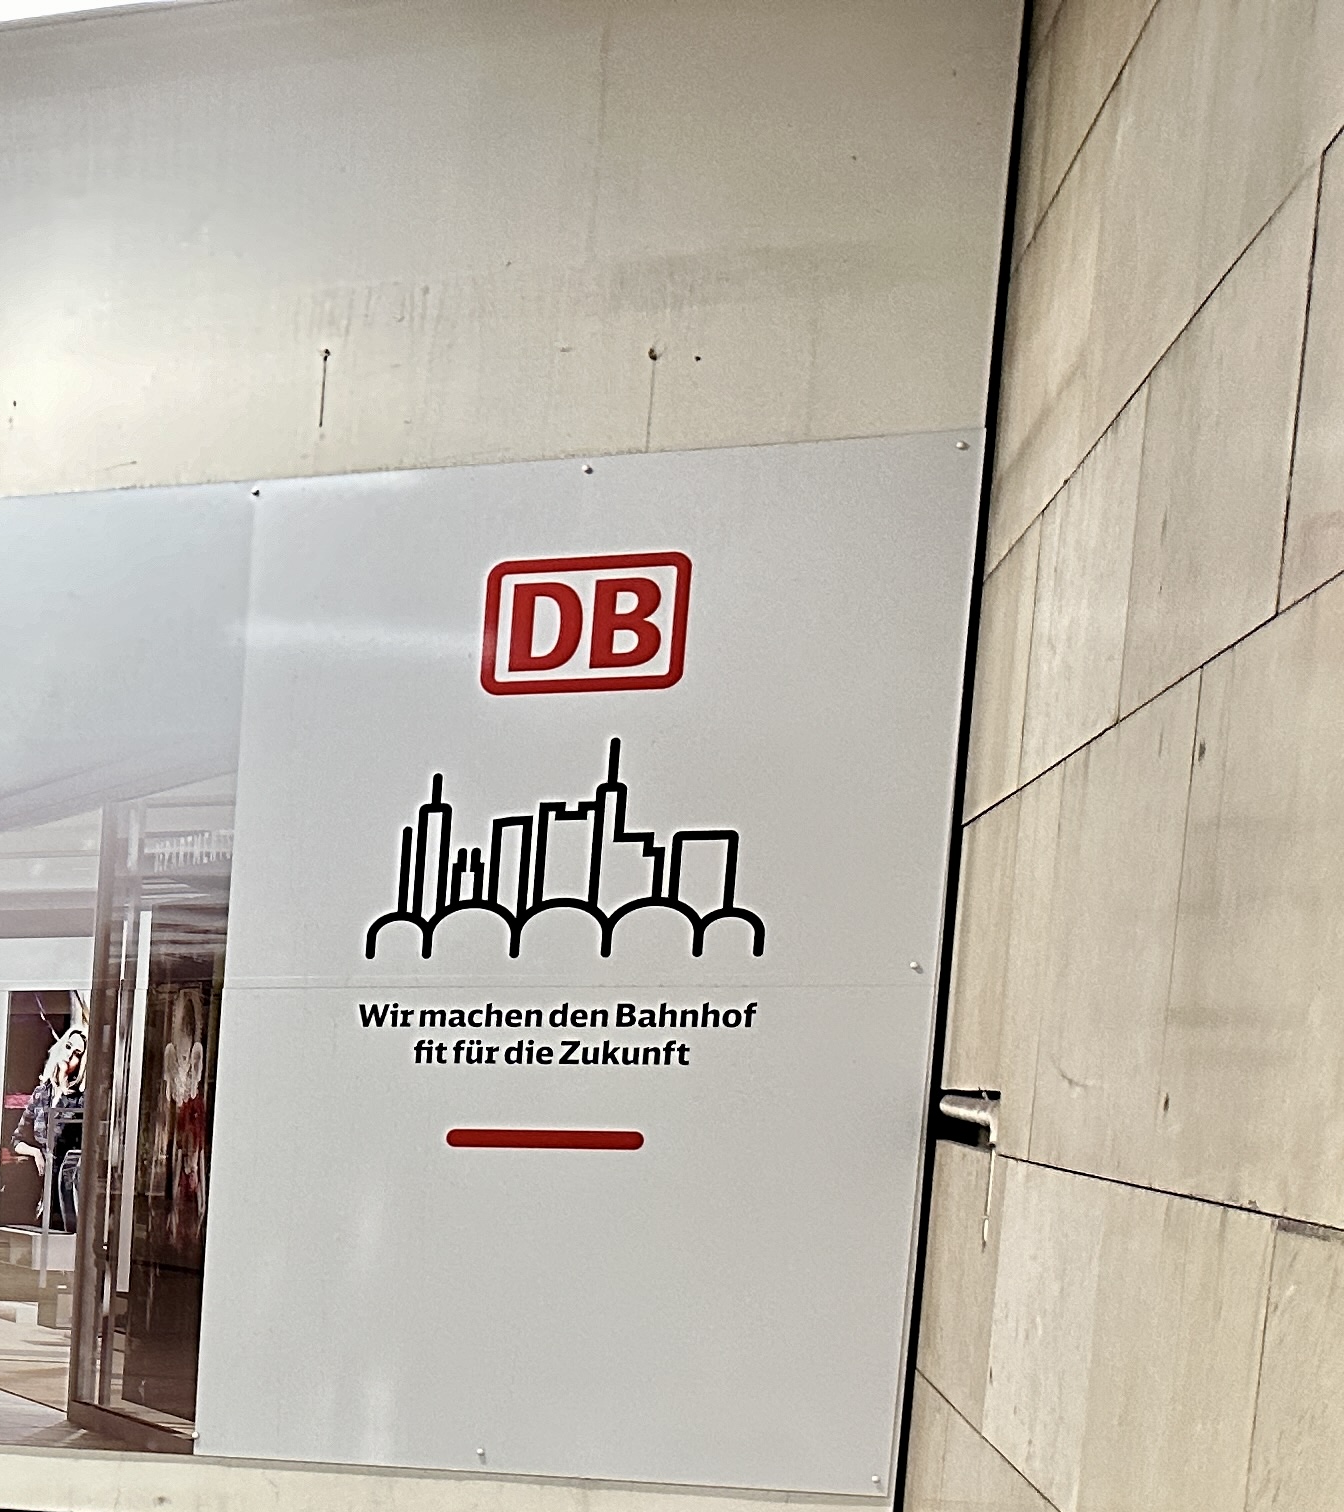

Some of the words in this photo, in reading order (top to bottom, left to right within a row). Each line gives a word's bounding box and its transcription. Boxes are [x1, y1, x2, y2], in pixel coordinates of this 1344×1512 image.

[506, 575, 665, 673] DB
[359, 1002, 415, 1028] Wir
[419, 1002, 543, 1028] machen
[548, 1002, 609, 1028] den
[615, 1001, 758, 1028] Bahnhof
[413, 1039, 448, 1065] fit
[452, 1039, 500, 1065] für
[504, 1039, 554, 1065] die
[558, 1039, 691, 1066] Zukunft
